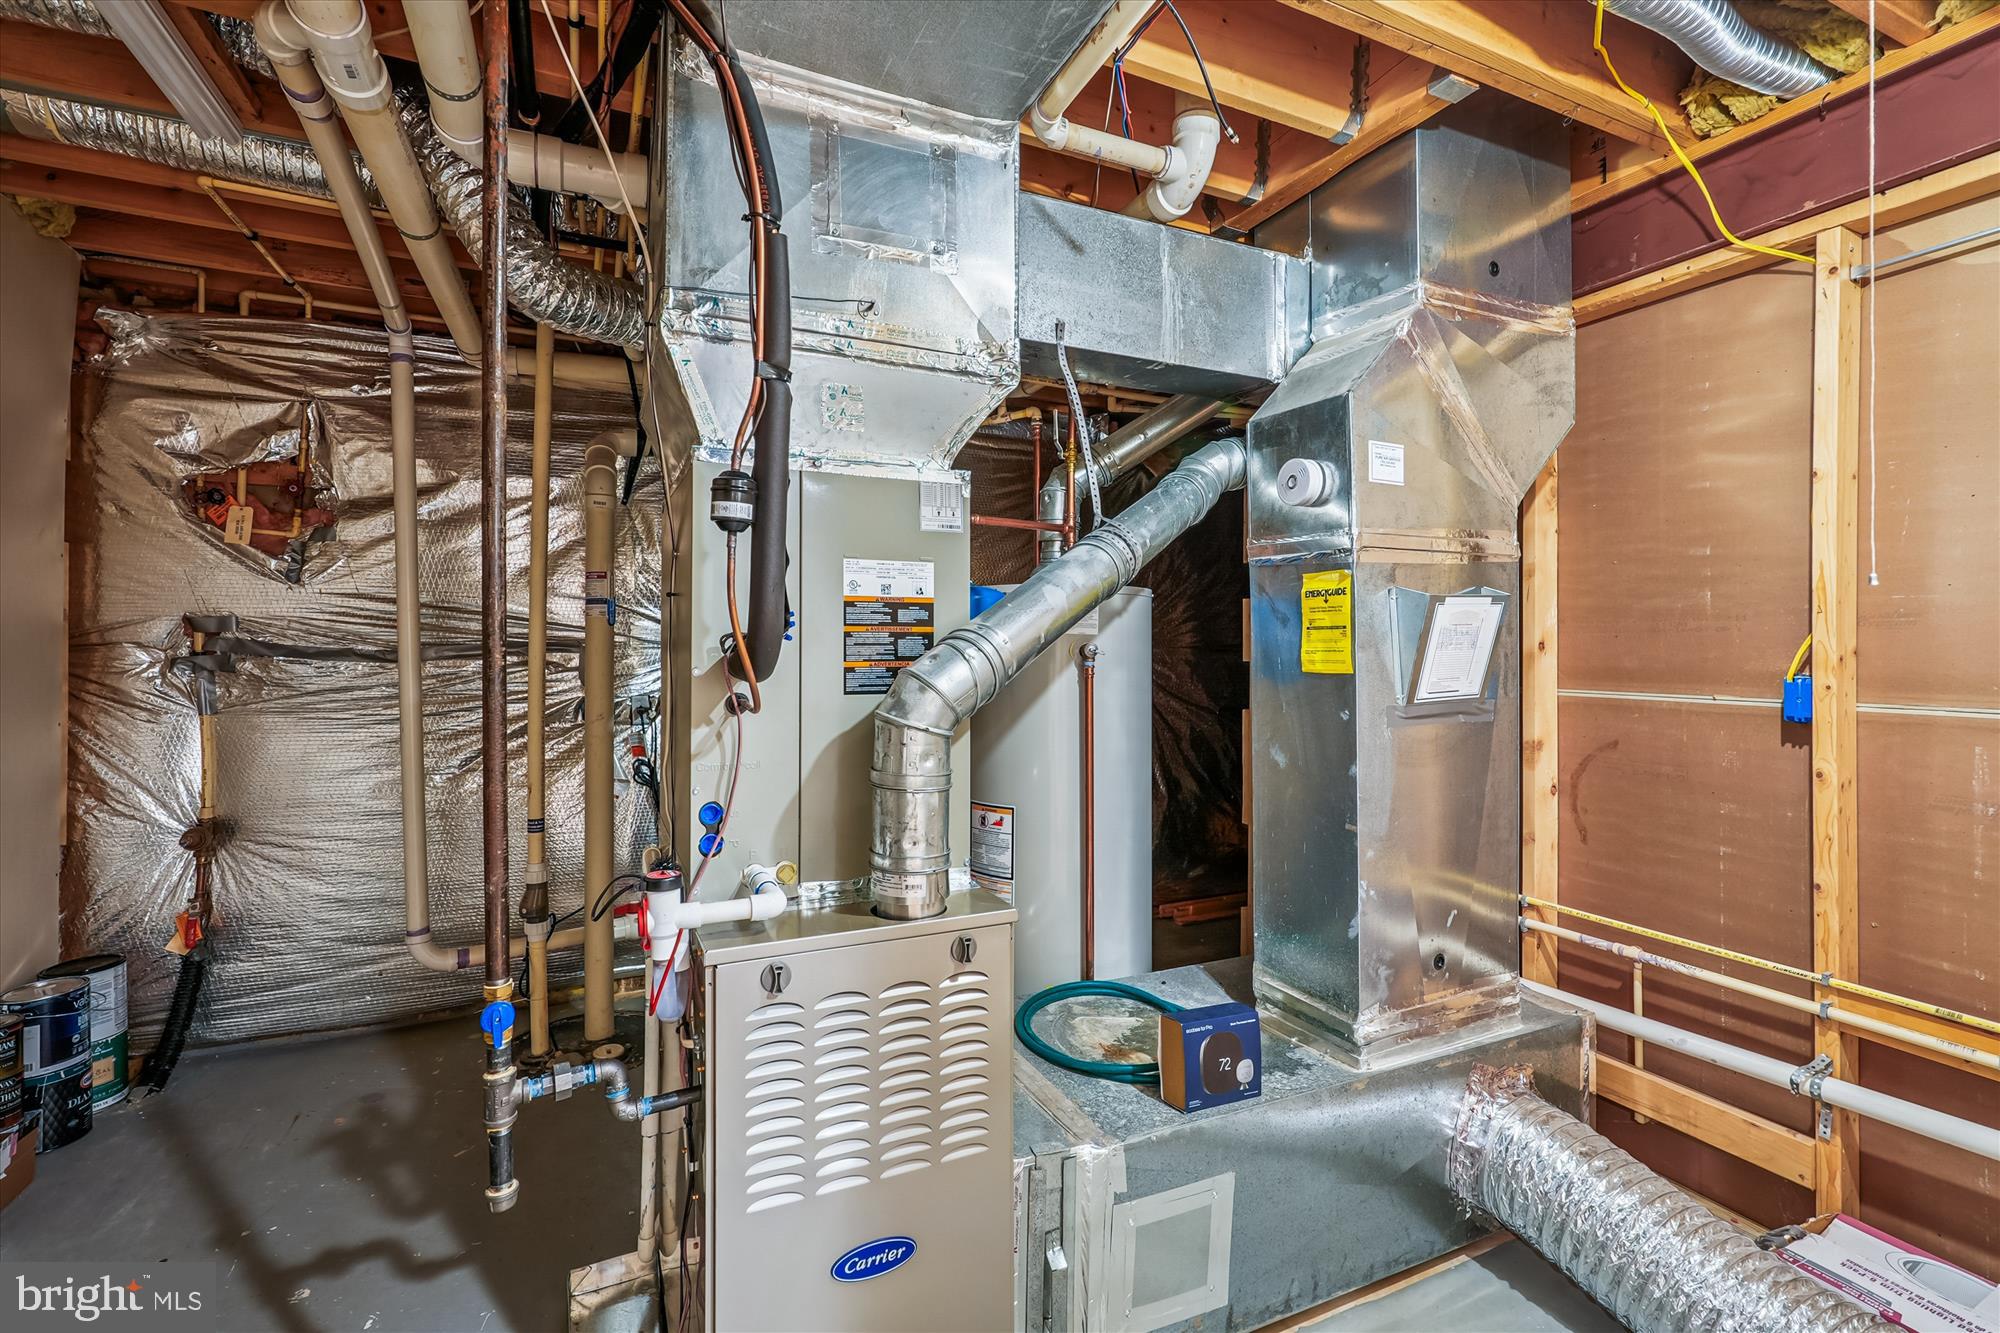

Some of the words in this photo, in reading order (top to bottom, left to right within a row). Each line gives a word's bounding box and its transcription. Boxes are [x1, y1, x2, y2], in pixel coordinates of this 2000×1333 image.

[1219, 1057, 1231, 1071] 72
[844, 1246, 906, 1274] Carrier
[1846, 1259, 1889, 1282] Empotradas
[1840, 1261, 1877, 1283] 6-Pack
[1880, 1282, 1903, 1297] Trim
[1891, 1280, 1913, 1296] Luces
[1907, 1296, 1955, 1324] Lighting
[1926, 1299, 1966, 1323] Molduras
